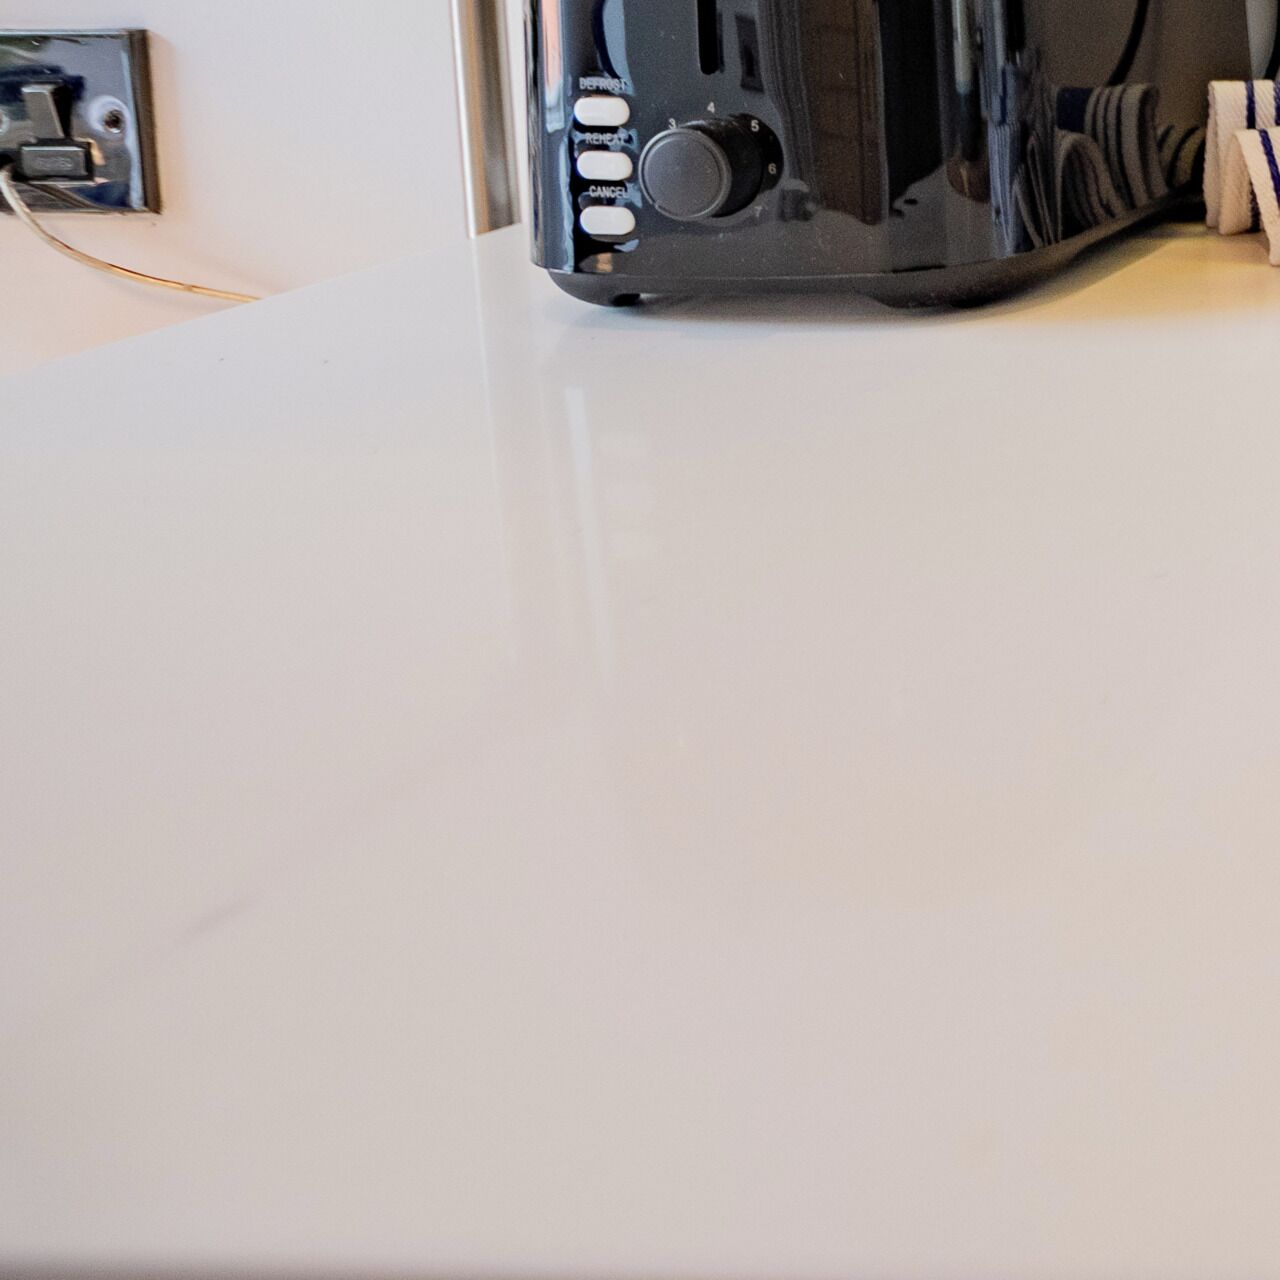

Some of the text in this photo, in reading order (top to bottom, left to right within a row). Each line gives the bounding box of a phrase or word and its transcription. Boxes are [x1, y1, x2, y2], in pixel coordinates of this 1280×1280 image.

[579, 77, 627, 91] DEFROST
[706, 101, 715, 114] 4
[668, 117, 677, 129] 3
[750, 119, 760, 132] 5
[768, 163, 777, 175] 6
[589, 185, 629, 199] CANCEL
